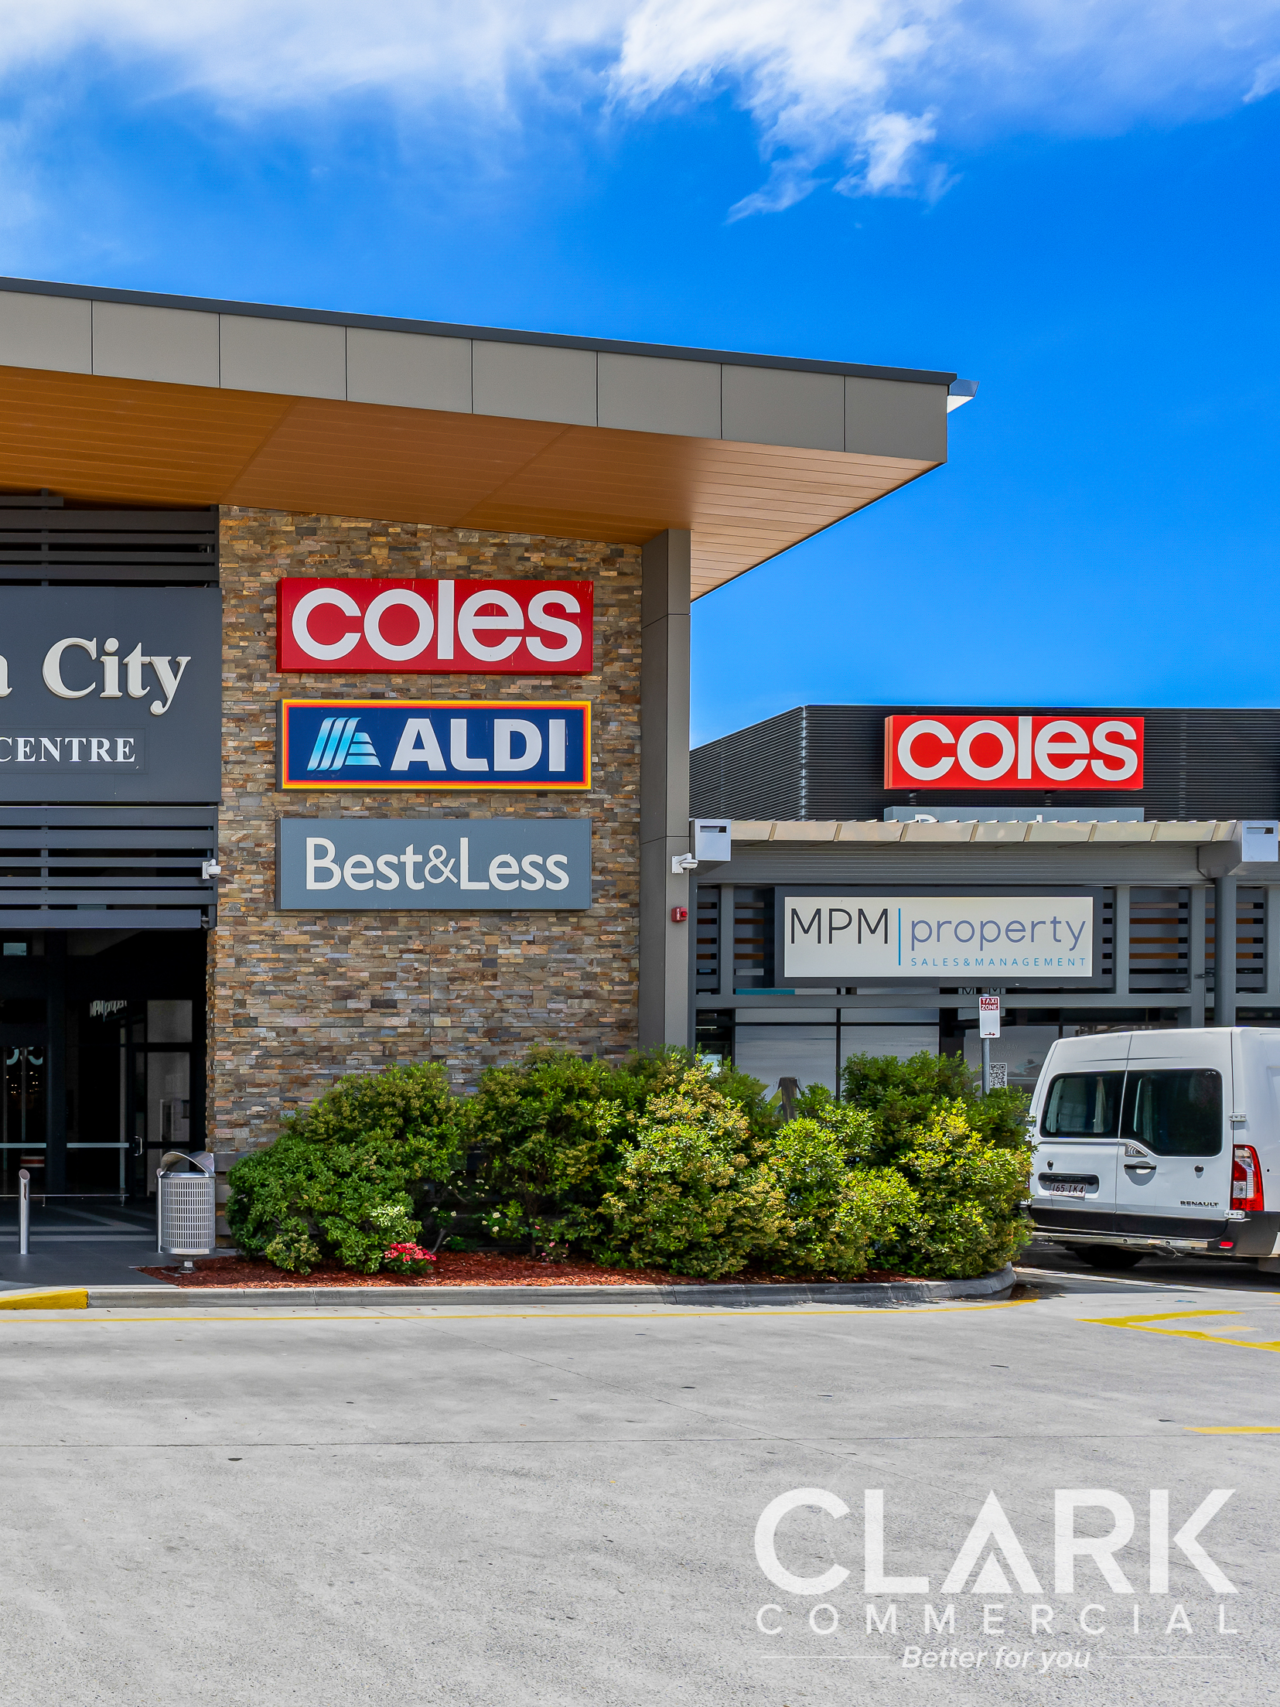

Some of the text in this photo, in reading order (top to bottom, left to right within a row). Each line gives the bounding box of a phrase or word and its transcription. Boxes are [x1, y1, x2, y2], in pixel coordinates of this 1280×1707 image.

[292, 580, 582, 662] coles
[43, 637, 191, 715] City
[390, 718, 566, 772] ALDI
[897, 715, 1138, 781] coles
[306, 837, 570, 891] Best&Less
[790, 908, 1087, 951] MPM property
[910, 957, 1087, 967] SALES&MANAGEMENT
